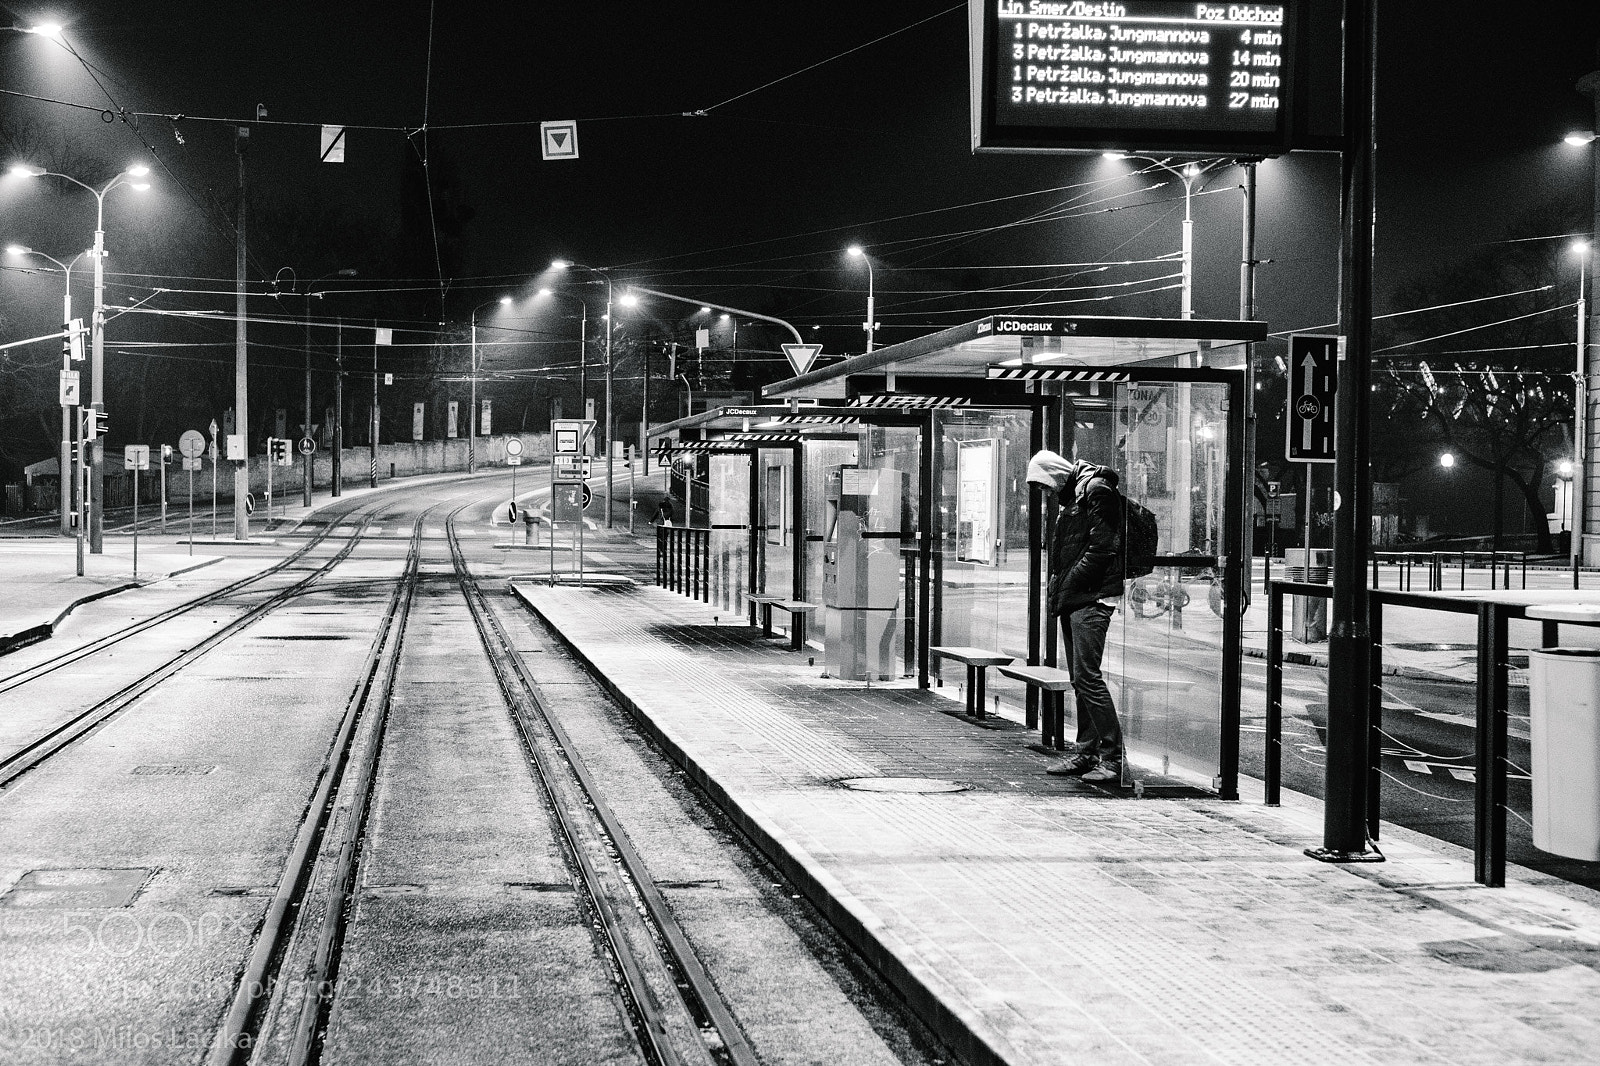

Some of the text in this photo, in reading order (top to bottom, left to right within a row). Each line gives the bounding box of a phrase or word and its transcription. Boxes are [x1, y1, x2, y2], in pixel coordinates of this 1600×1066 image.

[998, 0, 1126, 16] Lin Smer/Destin
[1197, 4, 1284, 21] Poz Odchod
[1015, 22, 1282, 46] 1 Petržalka, Jungmannova 4 min
[1013, 43, 1281, 66] 3 Petržalka, Jungmannova 14 min
[1014, 65, 1280, 88] 1 Petržalka, Jungmannova 20 min
[1012, 86, 1279, 109] 3 Petržalka, Jungmannova 27 min
[997, 321, 1053, 332] JCDecaux
[726, 408, 757, 416] JCDecaux
[1270, 484, 1276, 492] P
